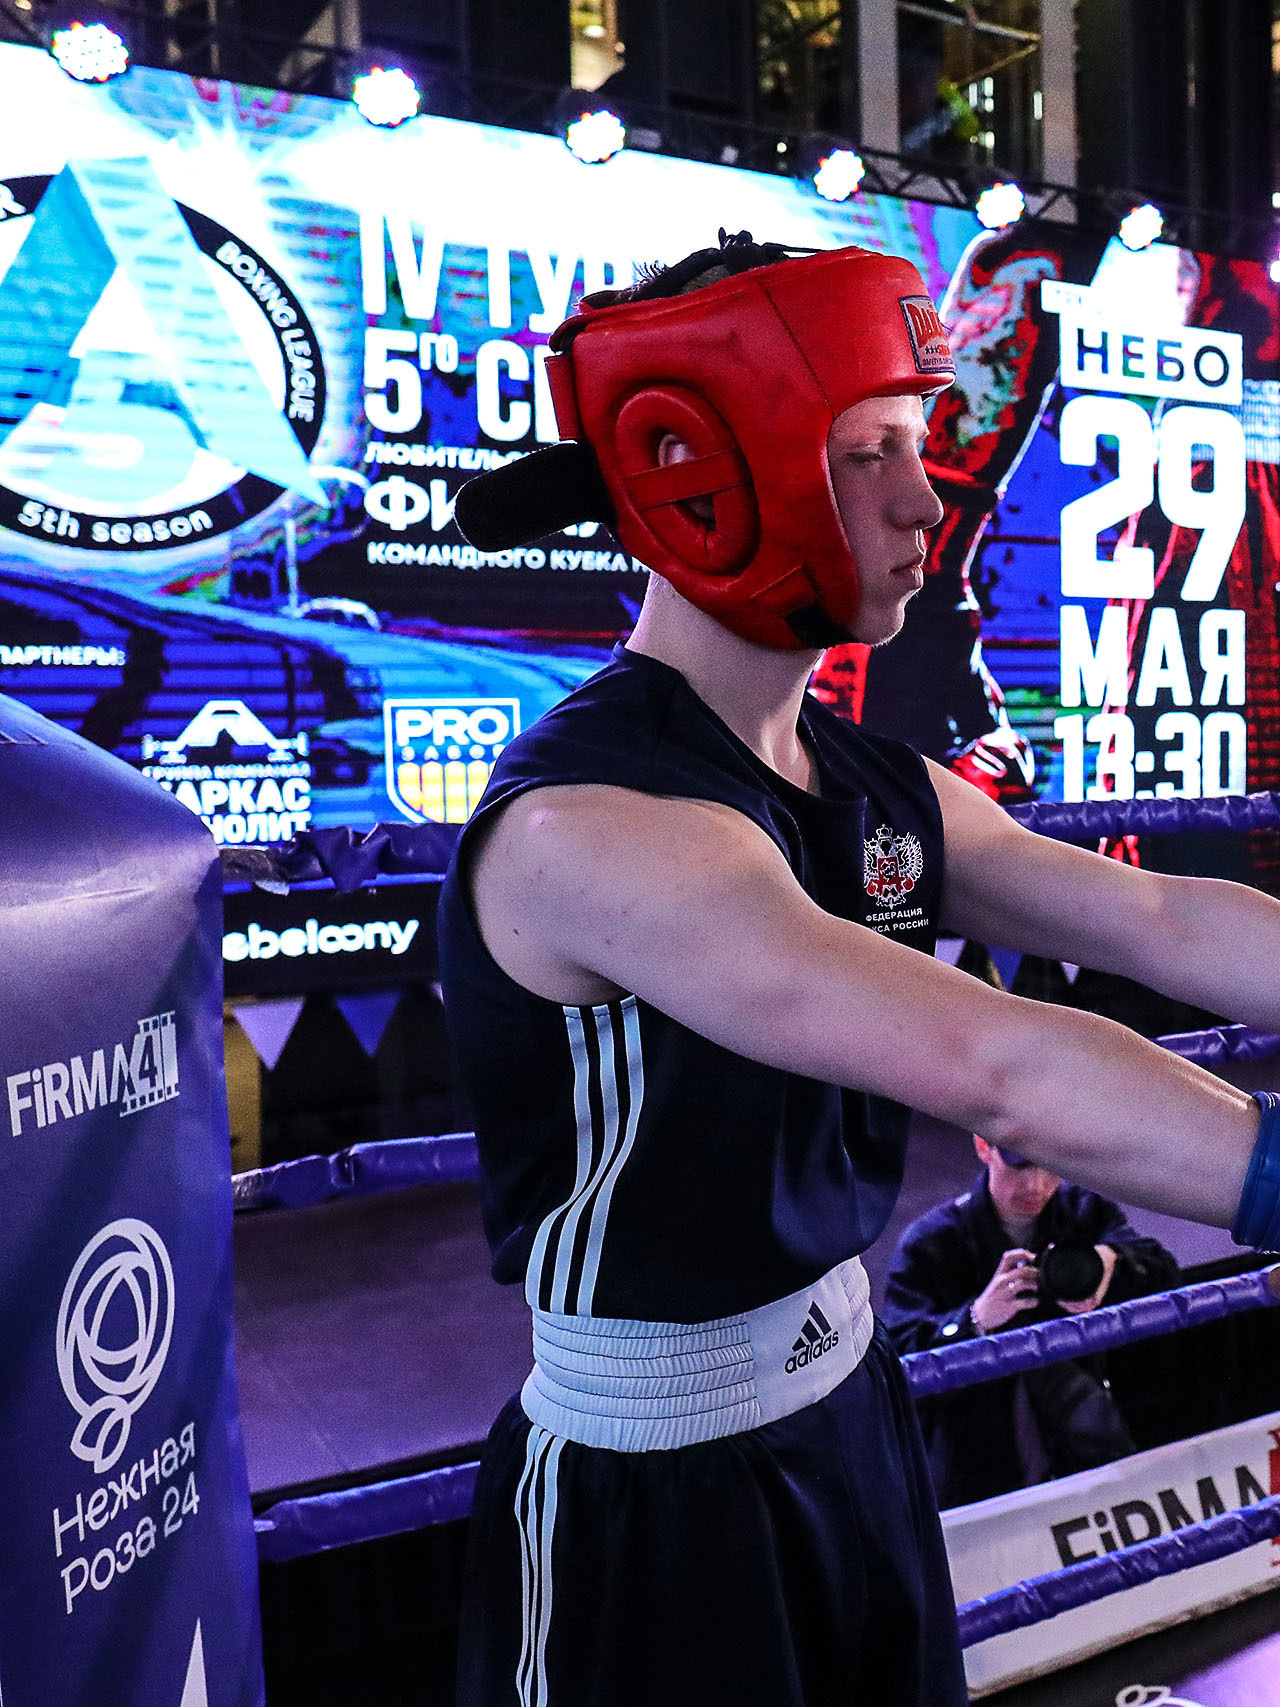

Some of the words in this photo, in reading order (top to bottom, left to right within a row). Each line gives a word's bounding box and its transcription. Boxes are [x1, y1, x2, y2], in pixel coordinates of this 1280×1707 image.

[216, 241, 298, 328] BOXING
[281, 328, 316, 422] LEAGUE
[1077, 328, 1229, 387] НЕБО
[17, 500, 80, 539] 5th
[92, 509, 213, 545] season
[1060, 395, 1247, 602] 29
[367, 541, 546, 569] КОМАНДНОГО
[550, 549, 628, 572] КУБКА
[1060, 605, 1246, 707] МАЯ
[396, 708, 509, 746] PRO
[1053, 711, 1247, 802] 13:30
[160, 777, 311, 815] АРКАС
[865, 907, 923, 922] ФЕДЕРАЦИЯ
[893, 918, 929, 931] РОССИИ
[783, 1330, 839, 1374] adidas
[53, 1421, 195, 1557] Нежная
[162, 1471, 200, 1539] 24
